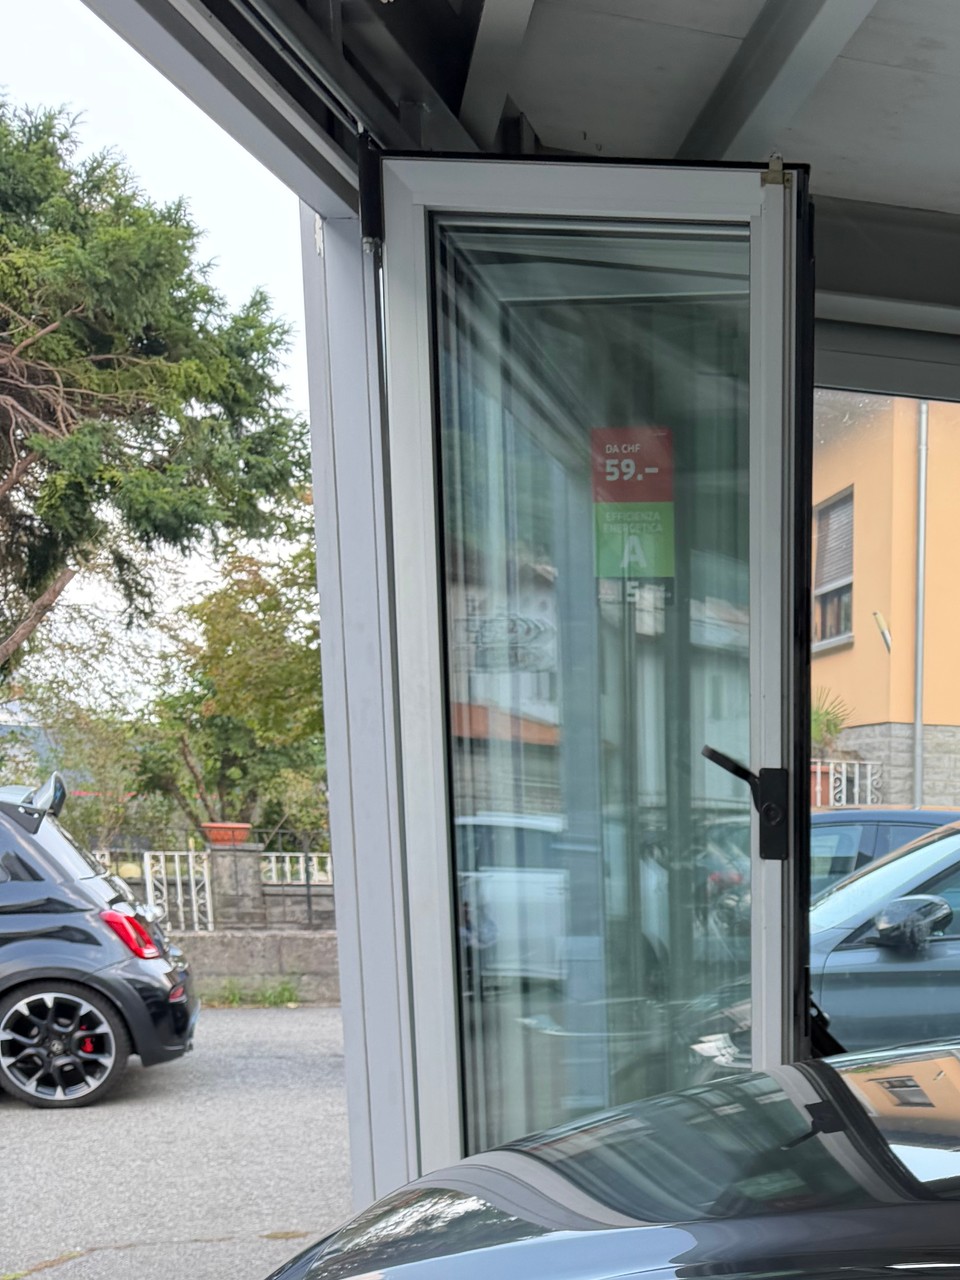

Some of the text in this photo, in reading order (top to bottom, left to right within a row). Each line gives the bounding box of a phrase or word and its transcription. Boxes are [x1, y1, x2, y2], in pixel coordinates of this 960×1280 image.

[605, 443, 641, 454] DA CHF
[606, 511, 661, 521] EFFICIENZA
[620, 534, 647, 568] A
